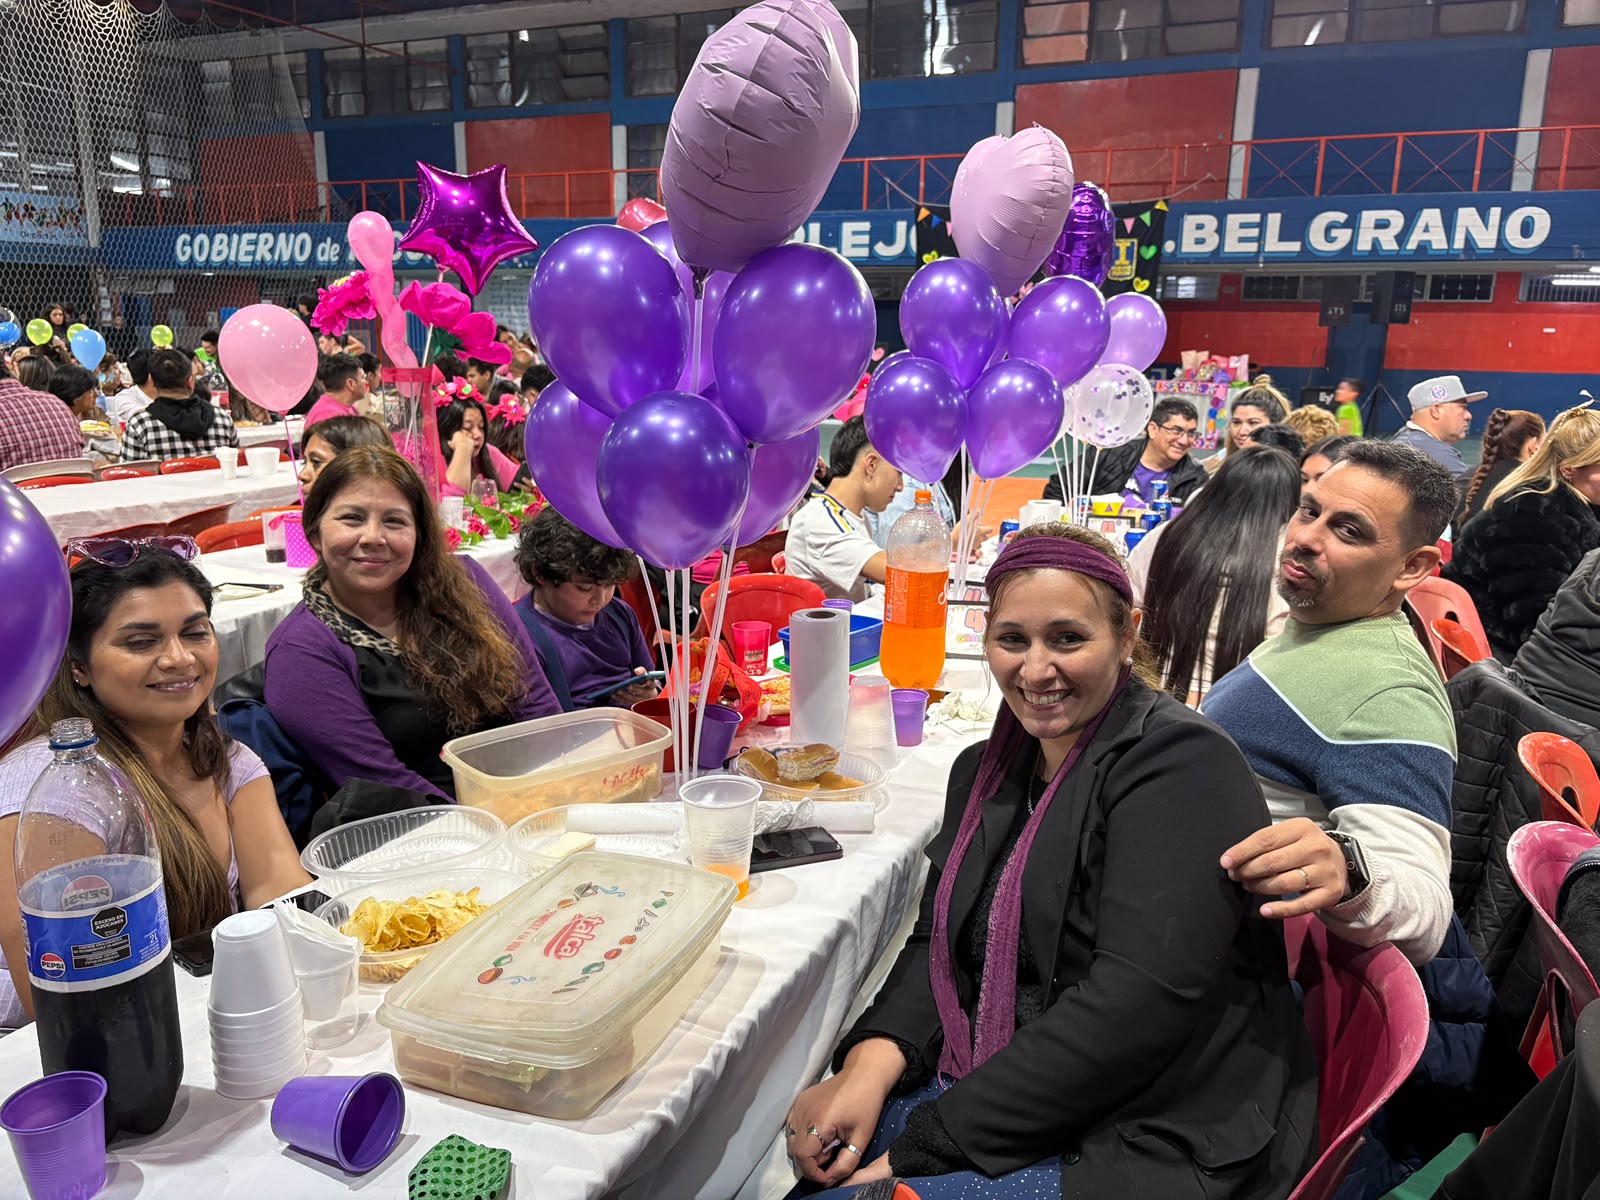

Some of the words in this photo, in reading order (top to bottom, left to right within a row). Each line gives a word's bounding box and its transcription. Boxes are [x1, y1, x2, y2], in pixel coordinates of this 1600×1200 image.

[175, 232, 313, 264] GOBIERNO
[316, 237, 341, 264] de
[94, 917, 116, 926] EXCESO
[557, 916, 605, 959] talca
[41, 960, 65, 969] PEPSI
